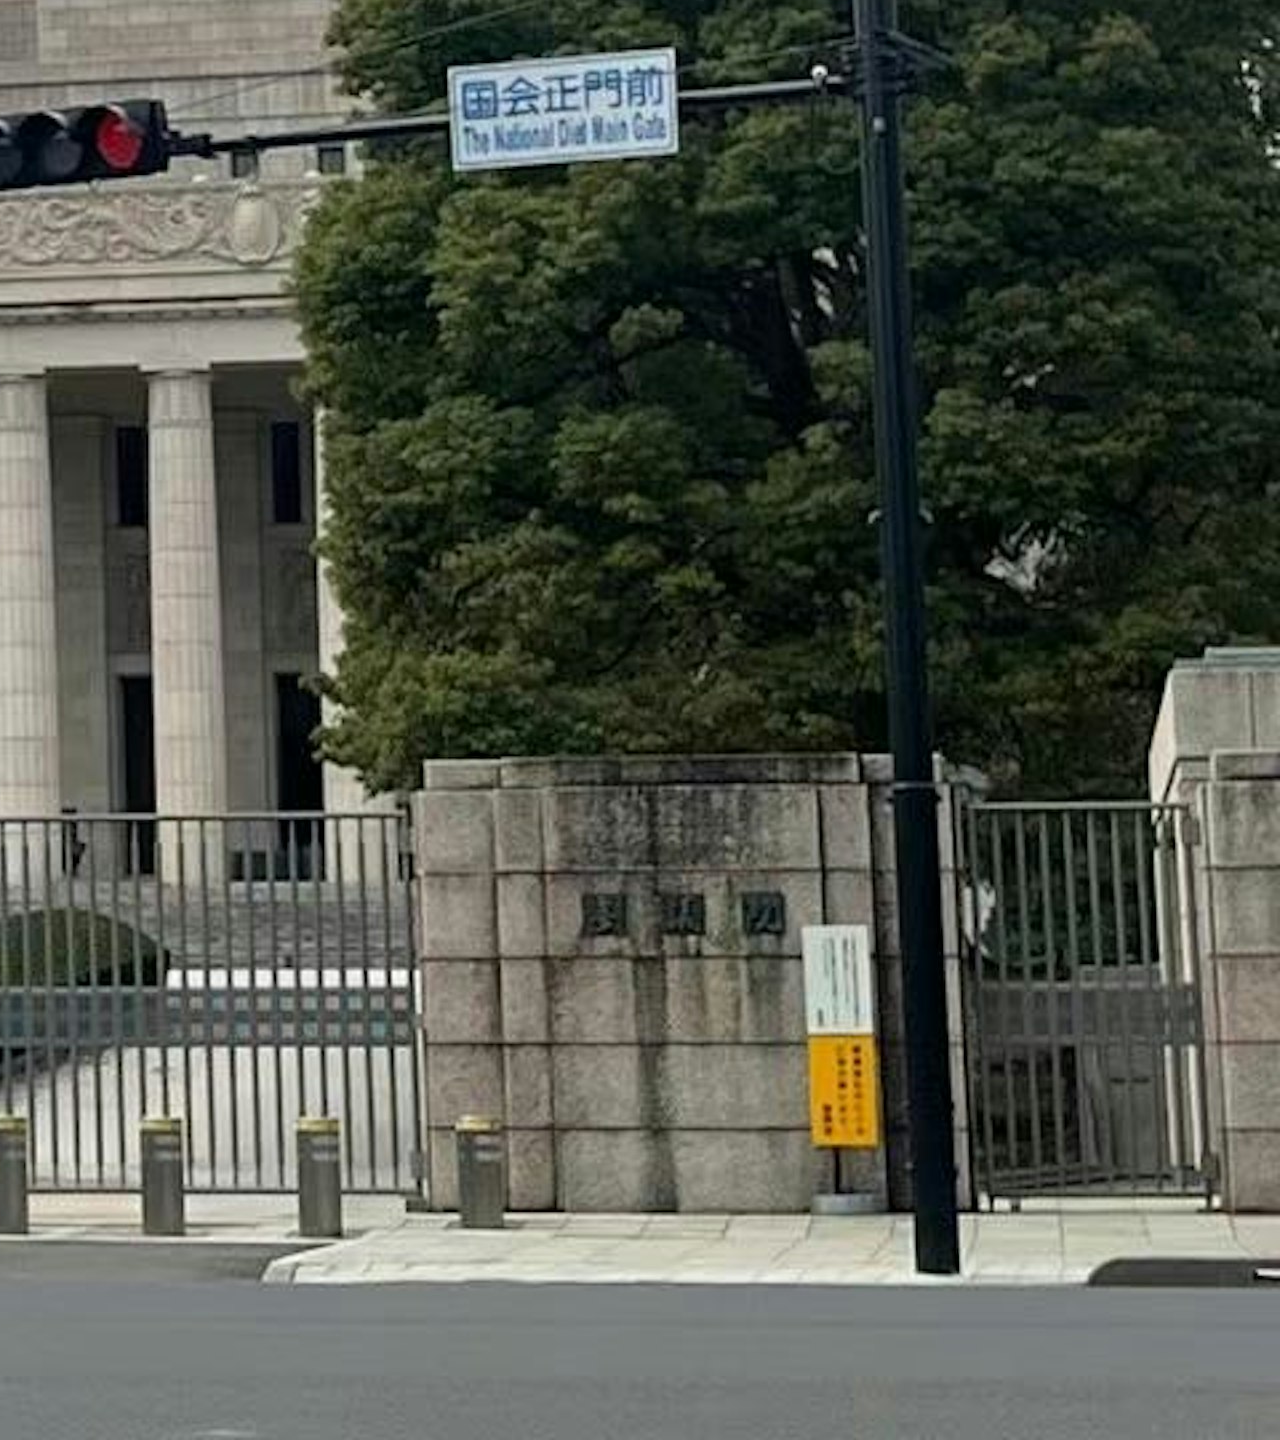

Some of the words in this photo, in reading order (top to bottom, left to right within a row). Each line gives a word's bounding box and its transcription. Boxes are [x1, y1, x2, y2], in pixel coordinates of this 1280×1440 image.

[461, 66, 664, 120] 国会正門前
[463, 126, 490, 156] The
[493, 120, 555, 151] National
[558, 117, 587, 148] Diet
[592, 115, 628, 143] Main
[633, 110, 667, 141] Gate
